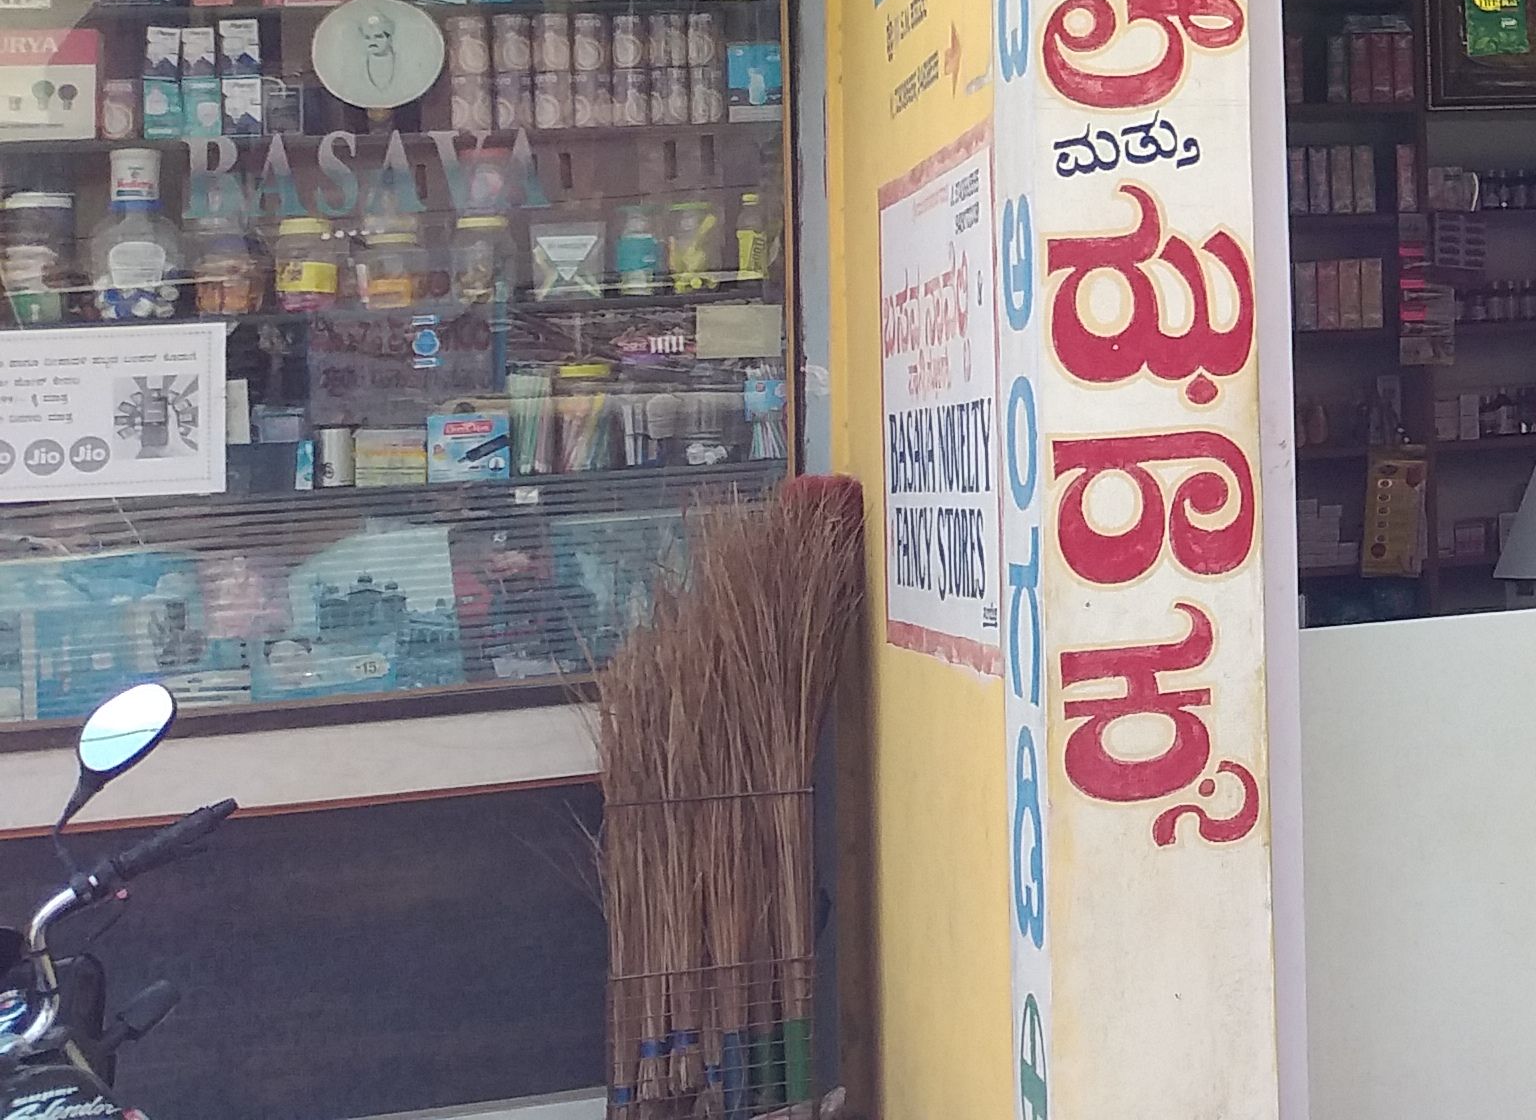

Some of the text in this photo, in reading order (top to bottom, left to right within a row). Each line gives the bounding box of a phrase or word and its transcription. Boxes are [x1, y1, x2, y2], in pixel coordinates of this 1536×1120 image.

[182, 129, 551, 218] BASAVA
[1051, 109, 1199, 178] ಮತ್ತು
[28, 447, 60, 466] Jio
[72, 444, 105, 463] Jio
[889, 397, 992, 497] BASAVA NOVELTY
[895, 505, 986, 601] FANCY STORES
